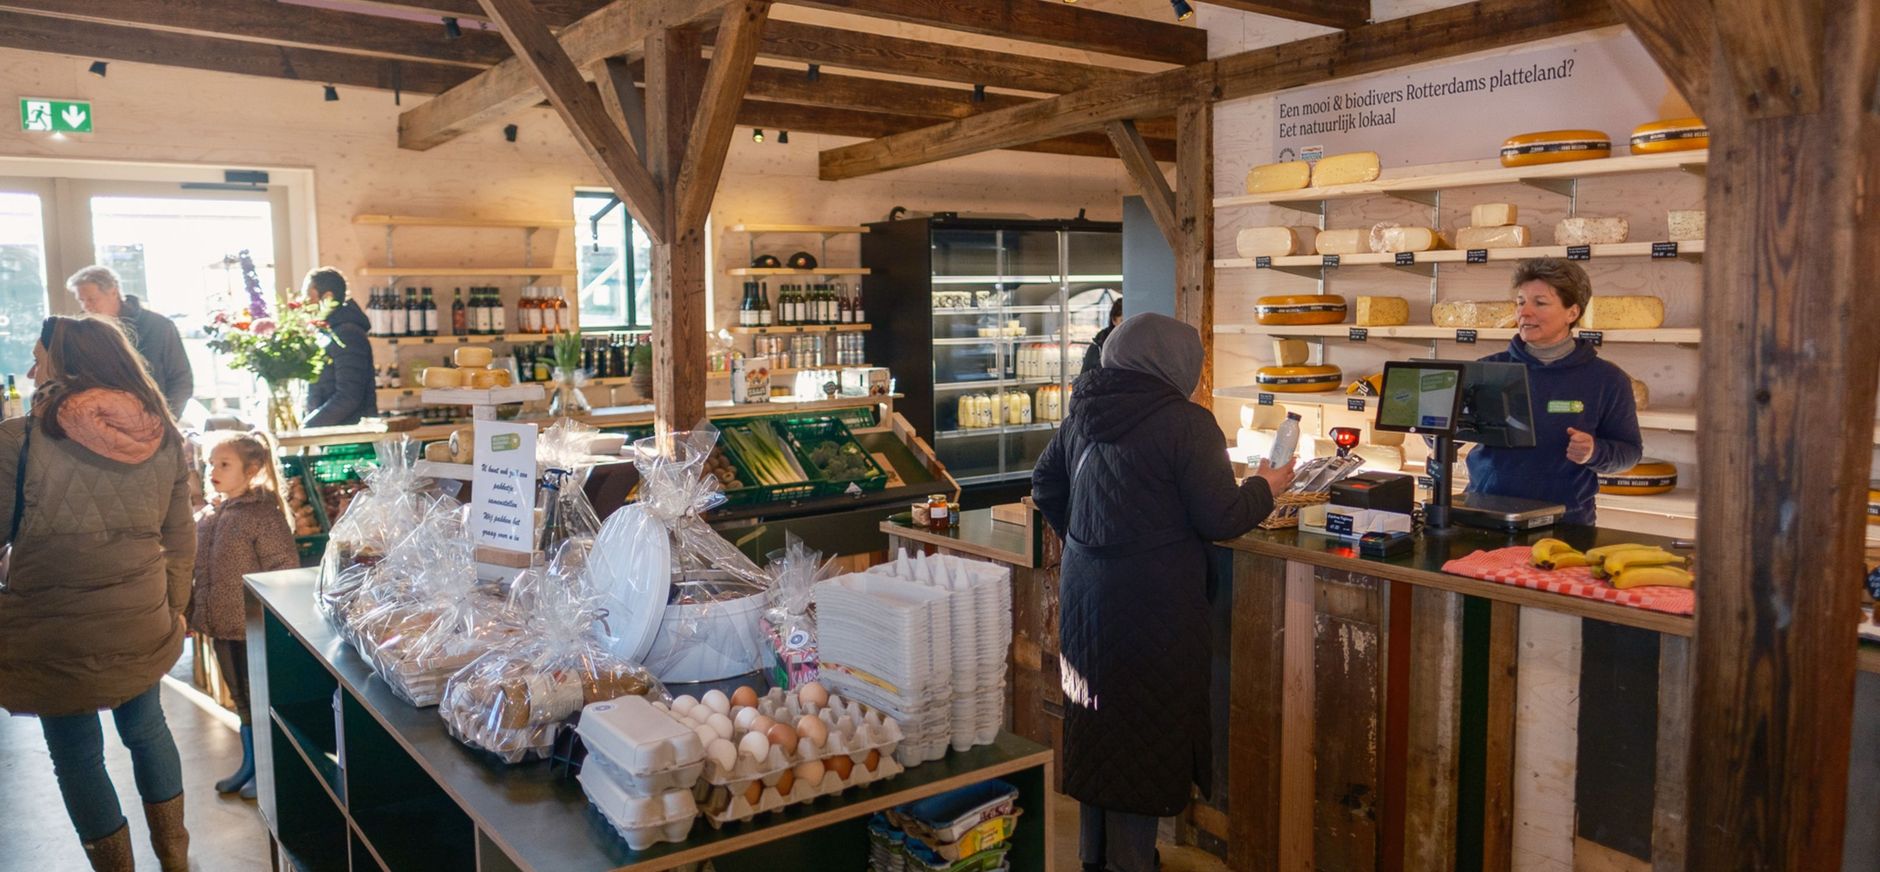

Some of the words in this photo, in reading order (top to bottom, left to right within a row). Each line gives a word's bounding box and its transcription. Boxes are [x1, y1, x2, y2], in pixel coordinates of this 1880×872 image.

[1280, 103, 1300, 119] Een
[1302, 97, 1330, 116] mooi
[1333, 95, 1342, 112] &
[1345, 89, 1404, 110] biodivers
[1406, 77, 1487, 101] Rotterdams
[1490, 58, 1575, 92] platteland?
[1280, 122, 1298, 139] Eet
[1300, 113, 1357, 136] natuurlijk
[1359, 107, 1396, 128] lokaal
